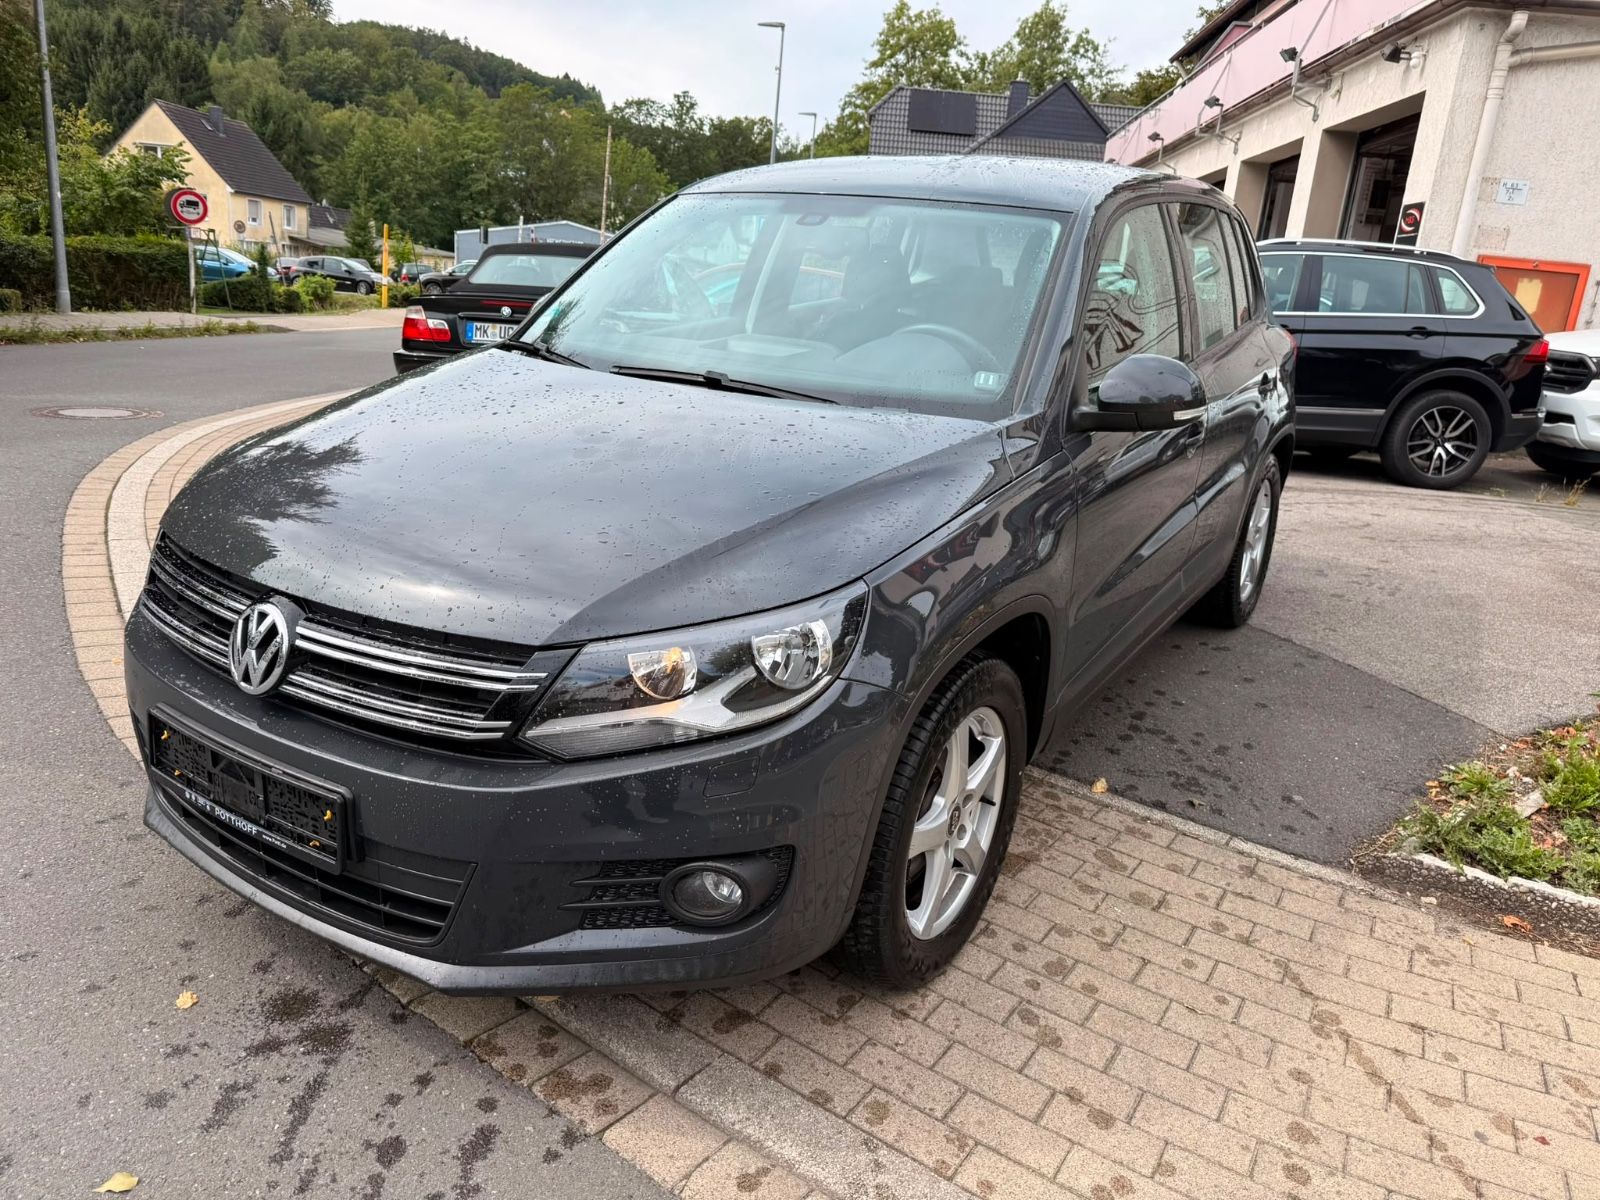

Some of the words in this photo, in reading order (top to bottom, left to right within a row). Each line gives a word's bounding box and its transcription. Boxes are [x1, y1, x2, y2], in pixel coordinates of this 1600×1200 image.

[474, 324, 490, 339] MK
[233, 604, 287, 692] VW
[214, 807, 258, 836] POTTHOFF
